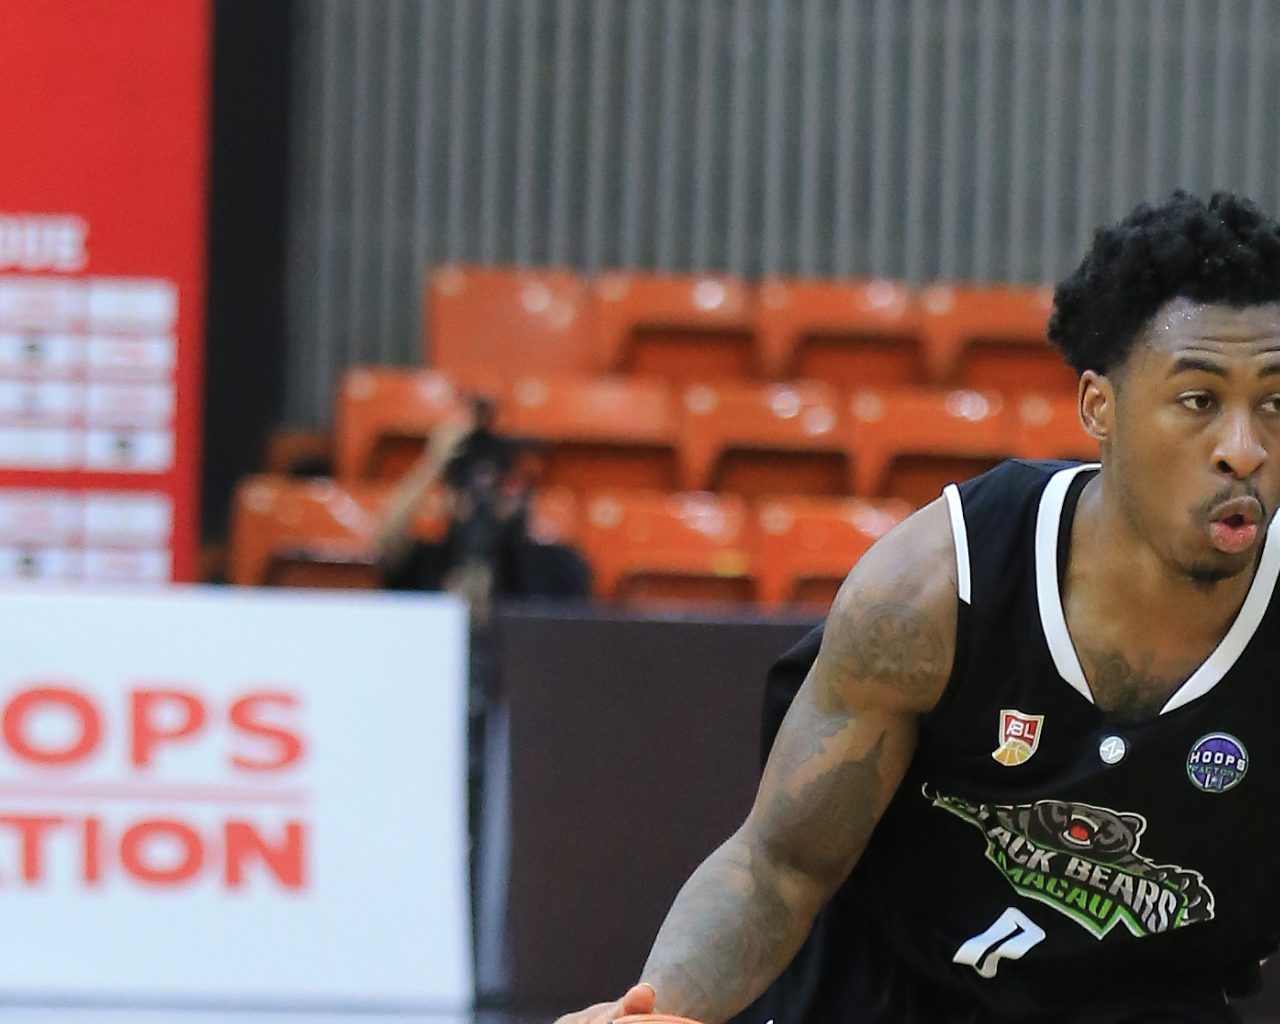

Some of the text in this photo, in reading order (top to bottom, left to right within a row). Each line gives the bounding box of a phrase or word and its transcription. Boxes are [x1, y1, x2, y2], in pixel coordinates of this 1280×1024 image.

[2, 687, 305, 771] OPS
[1006, 718, 1035, 739] ABL
[1190, 750, 1246, 772] HOOPS
[988, 826, 1178, 934] ACK BEARS
